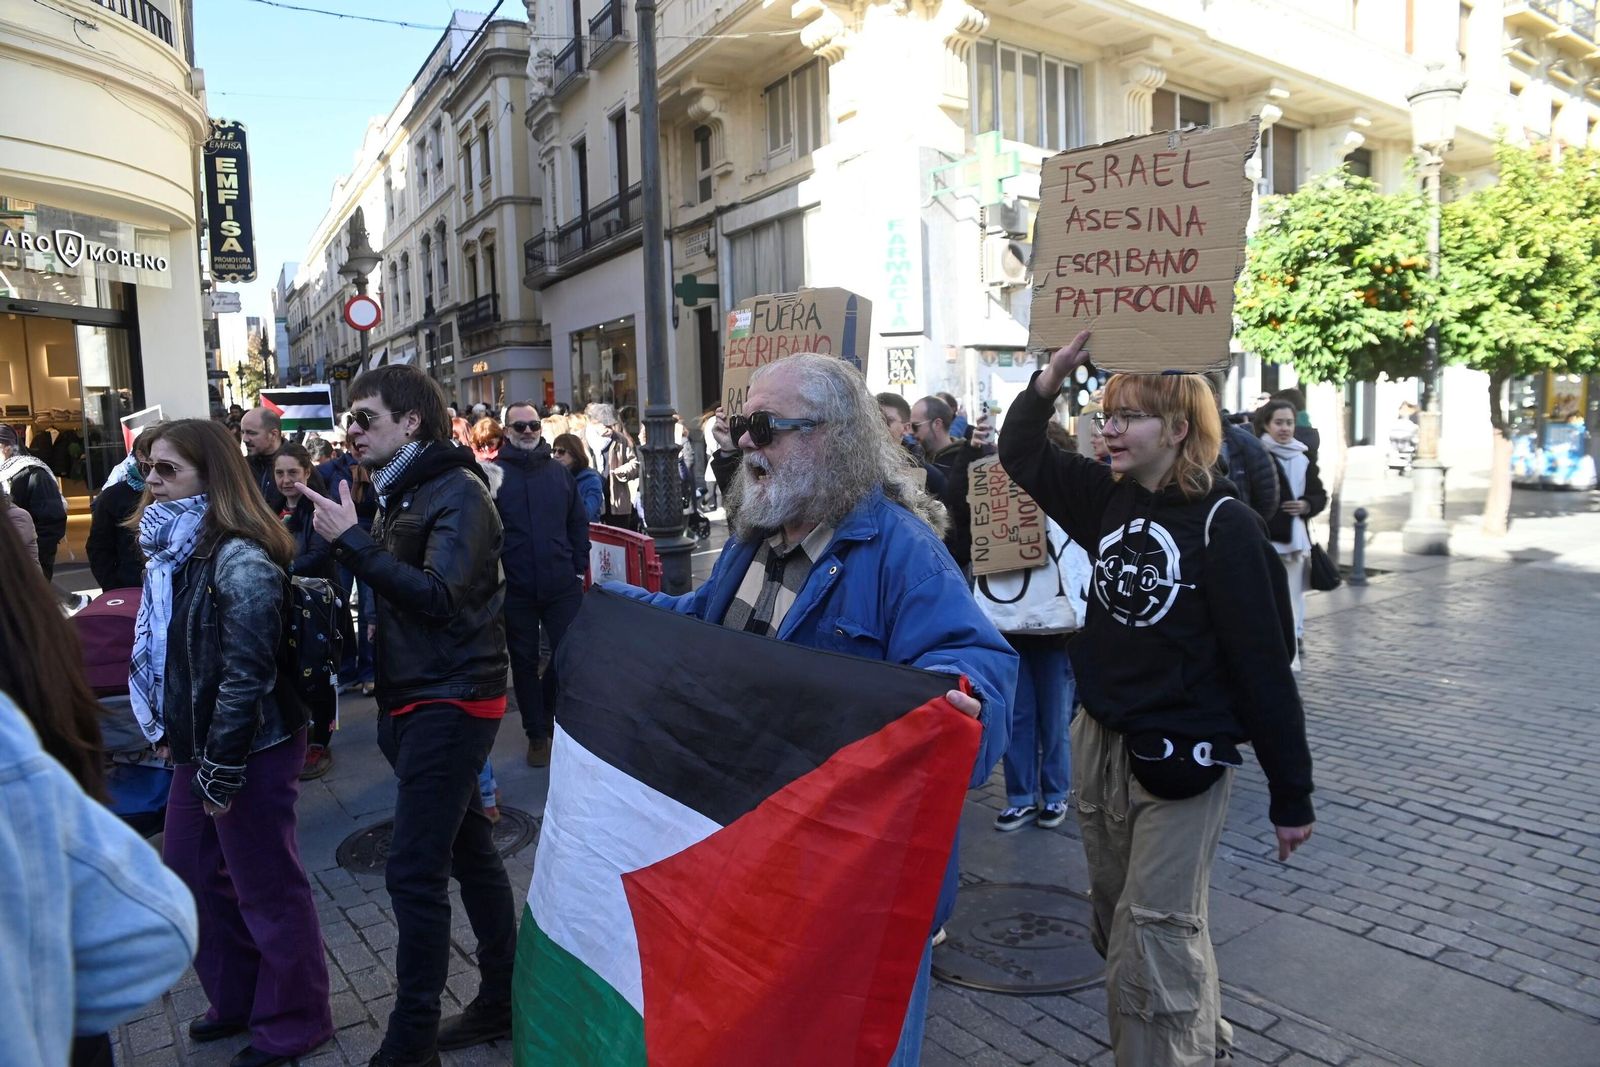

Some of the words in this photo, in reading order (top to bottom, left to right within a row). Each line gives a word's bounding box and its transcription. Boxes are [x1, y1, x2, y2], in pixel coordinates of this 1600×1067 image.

[210, 140, 242, 150] EMFISA
[1060, 149, 1210, 203] ISRAEL
[215, 157, 243, 253] EMFISA
[1066, 205, 1207, 237] ASESINA
[87, 244, 169, 272] MORENO
[885, 219, 912, 327] FARMACIA
[1056, 248, 1199, 277] ESCRIBANO
[752, 299, 822, 333] FUERA
[1055, 284, 1216, 317] PATROCINA
[728, 333, 832, 368] ESCRIBANO
[973, 463, 989, 496] UNA
[975, 502, 989, 526] ES
[989, 462, 1008, 539] GUERRA
[975, 536, 989, 562] NO
[1009, 525, 1018, 542] ES
